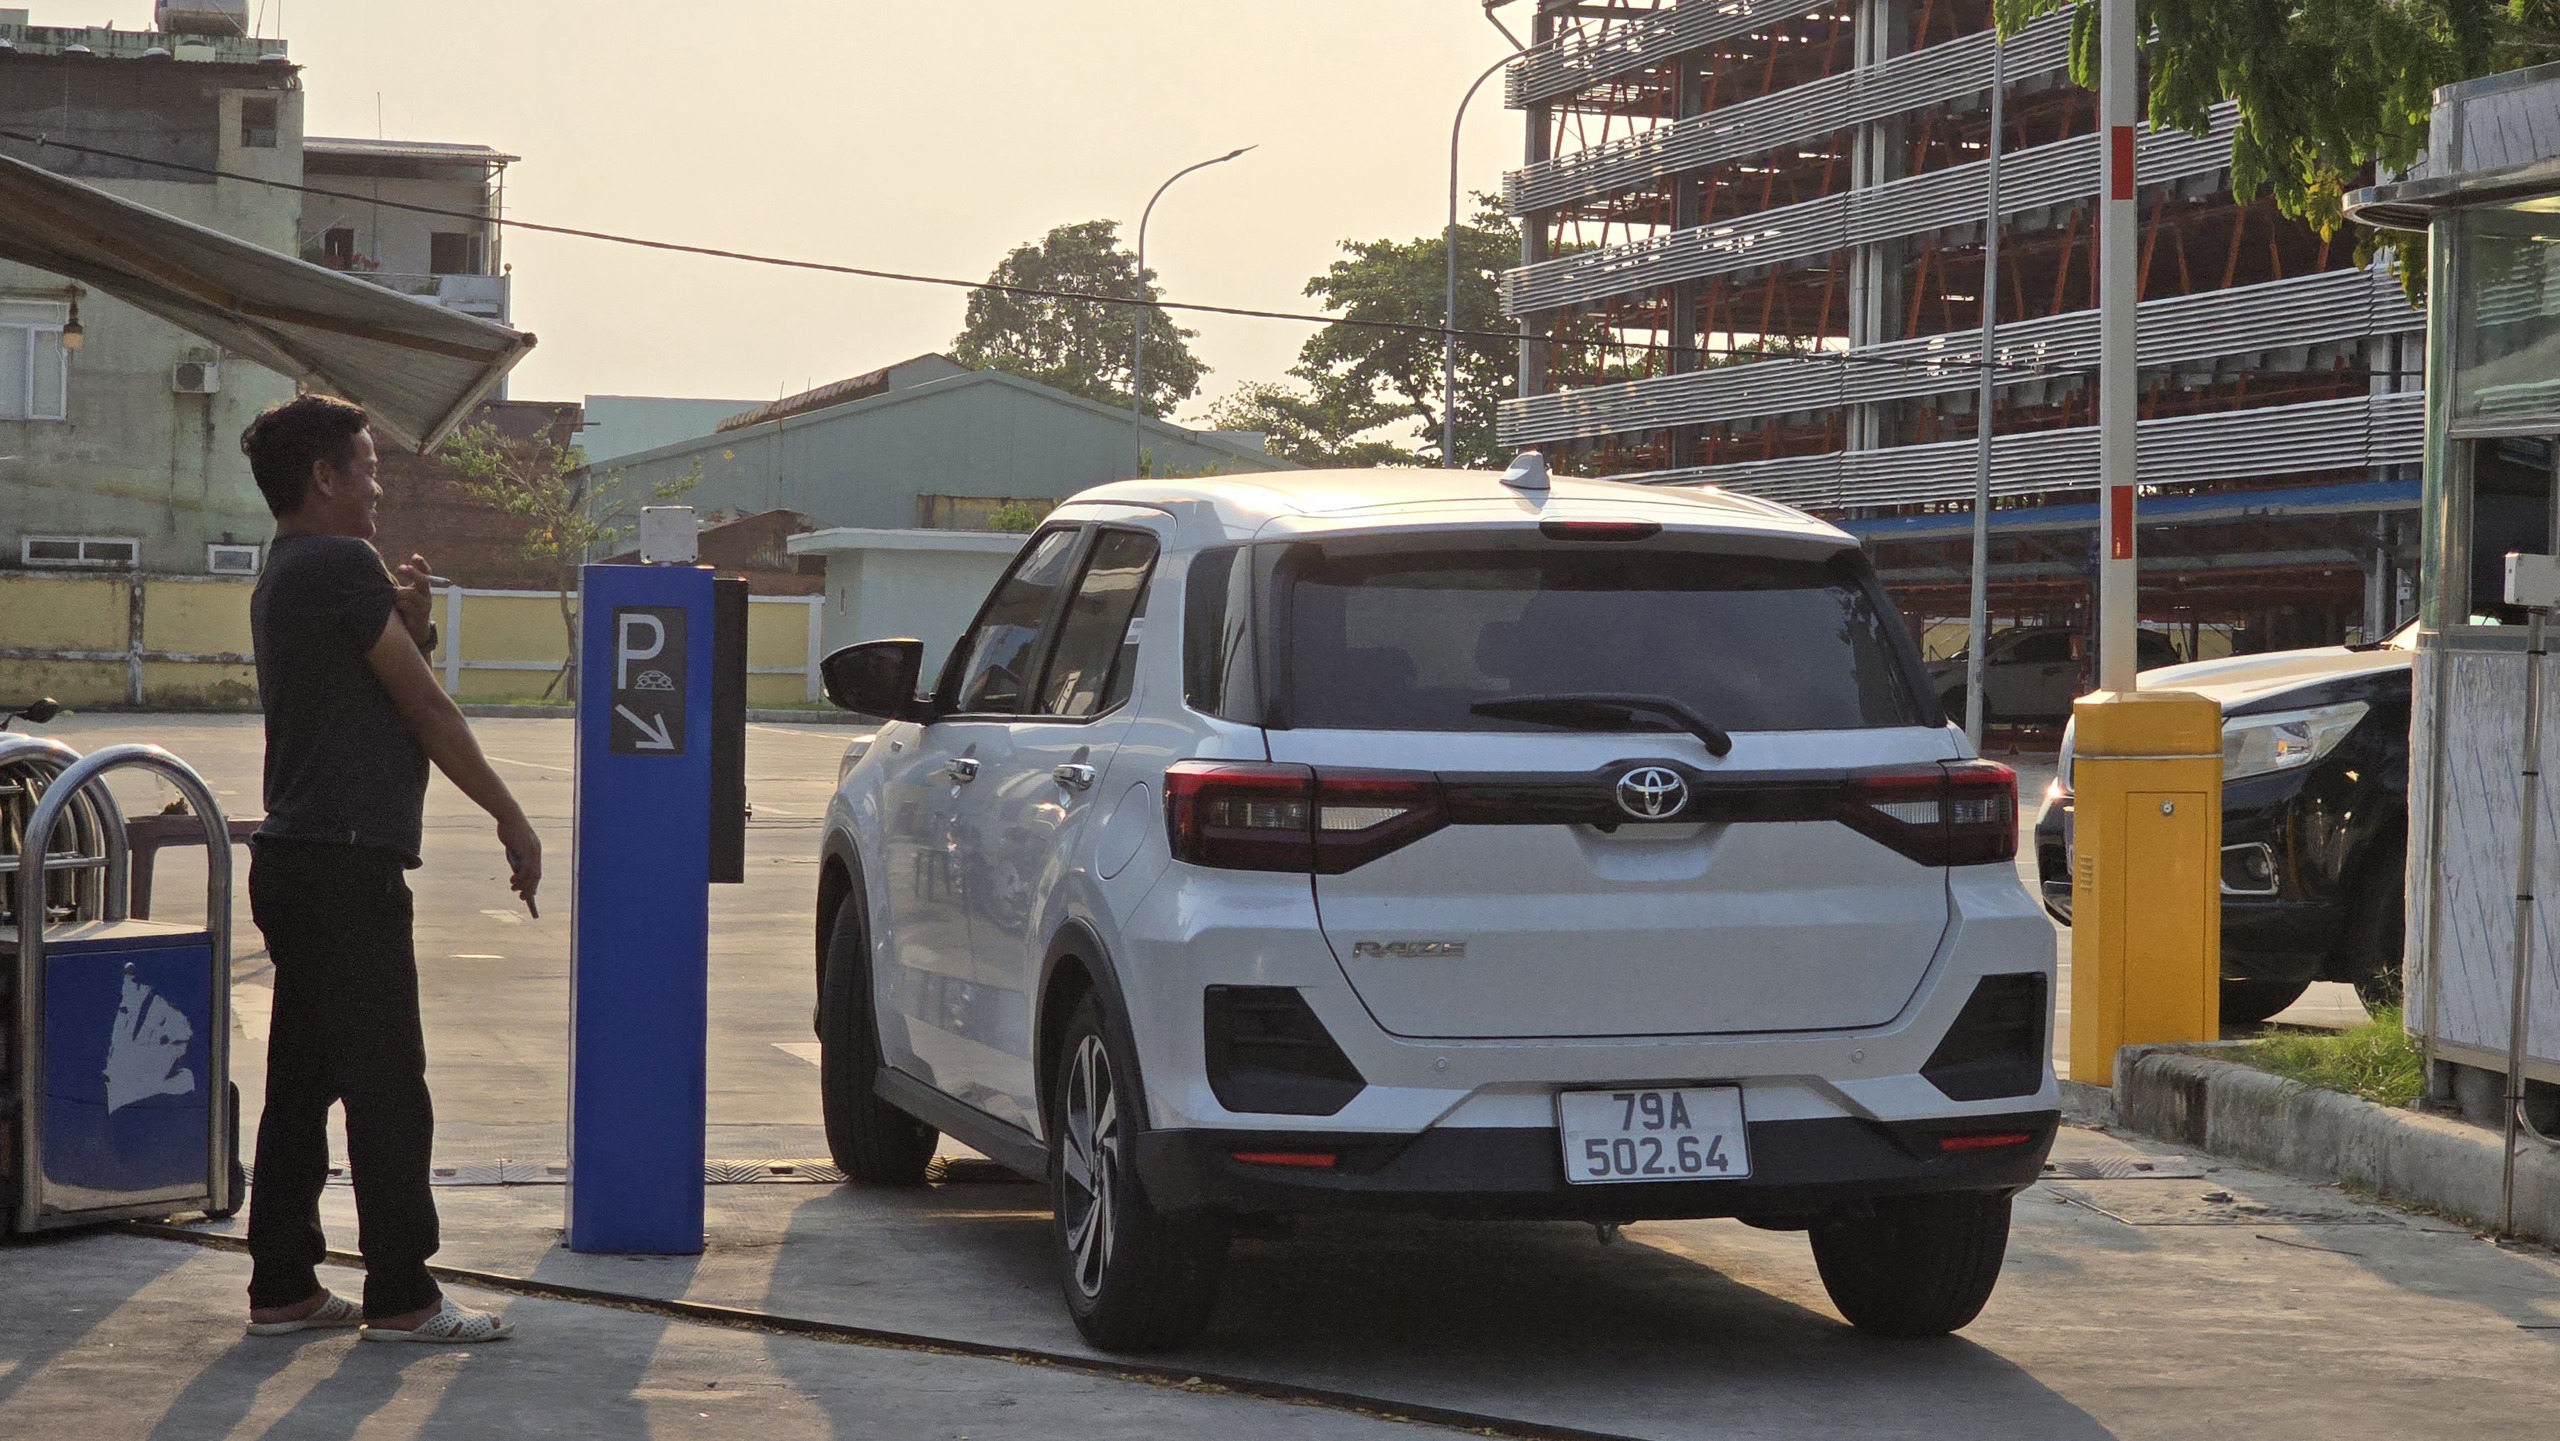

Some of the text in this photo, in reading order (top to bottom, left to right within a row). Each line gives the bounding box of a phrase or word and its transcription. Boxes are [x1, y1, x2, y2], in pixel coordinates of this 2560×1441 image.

[618, 613, 665, 690] P
[1353, 942, 1467, 958] RAIZE
[1613, 1092, 1692, 1131] 79A
[1585, 1135, 1728, 1176] 502.64
